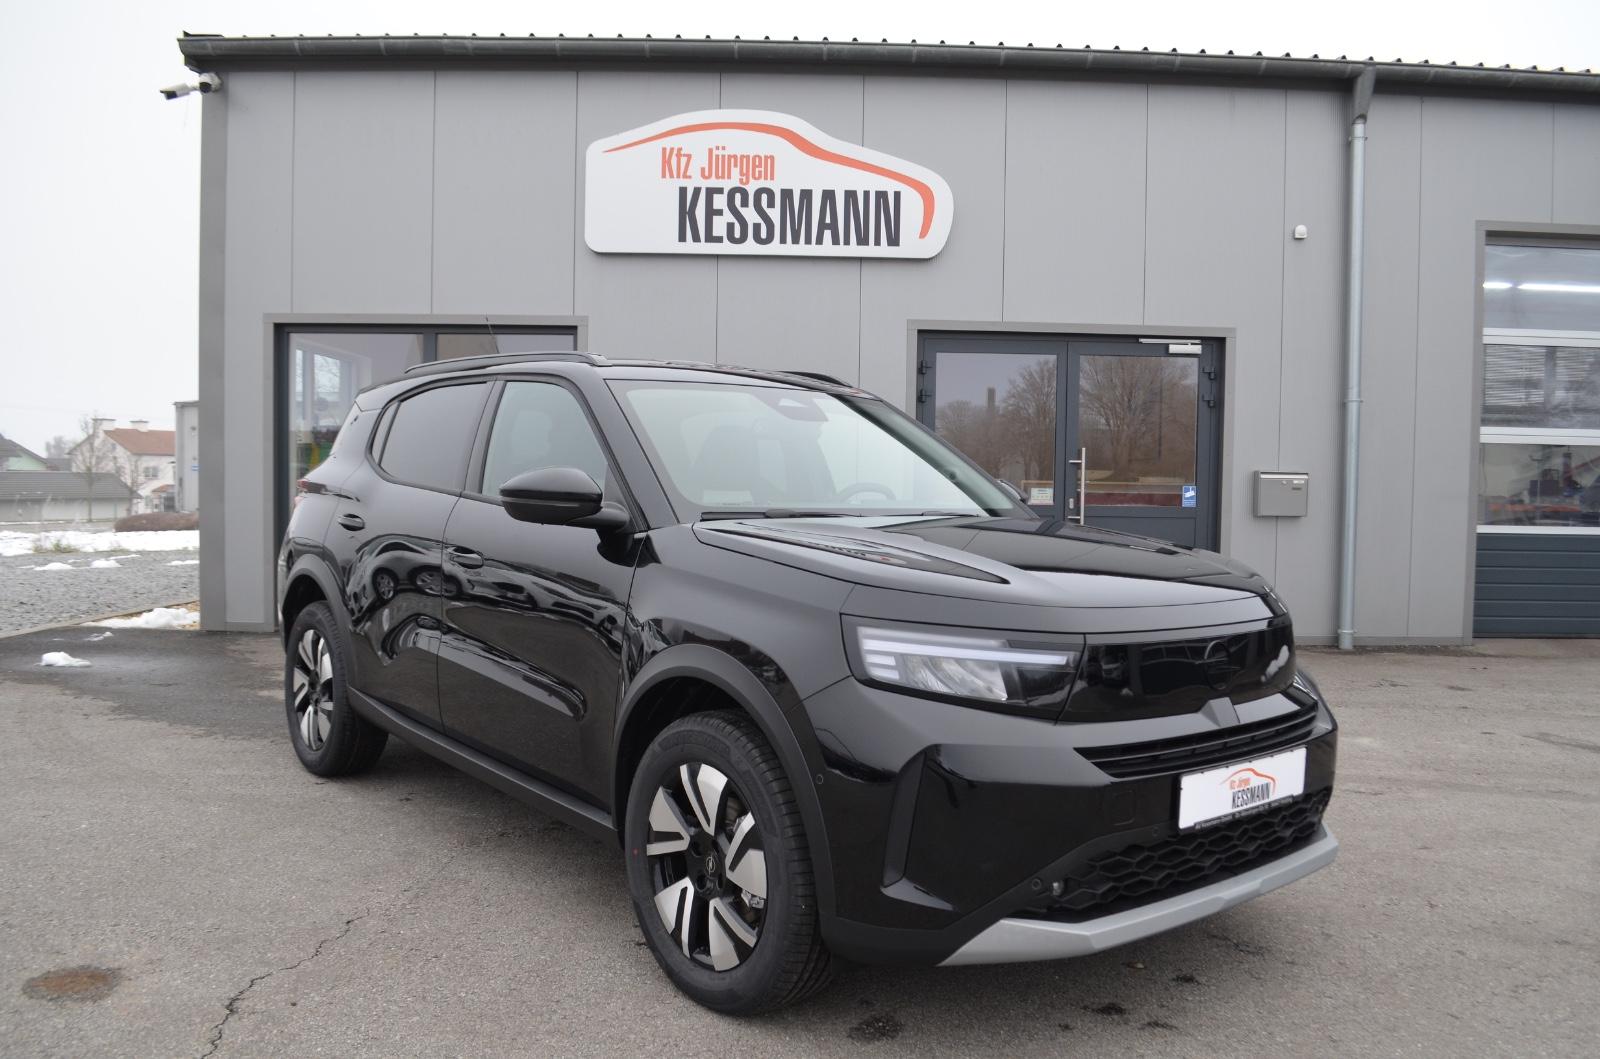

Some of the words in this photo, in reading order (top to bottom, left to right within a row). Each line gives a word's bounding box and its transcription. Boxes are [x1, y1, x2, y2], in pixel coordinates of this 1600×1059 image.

[661, 146, 692, 179] Kfz
[700, 145, 775, 186] Jürgen
[677, 186, 901, 247] KESSMANN
[1232, 782, 1271, 810] KESSMANN
